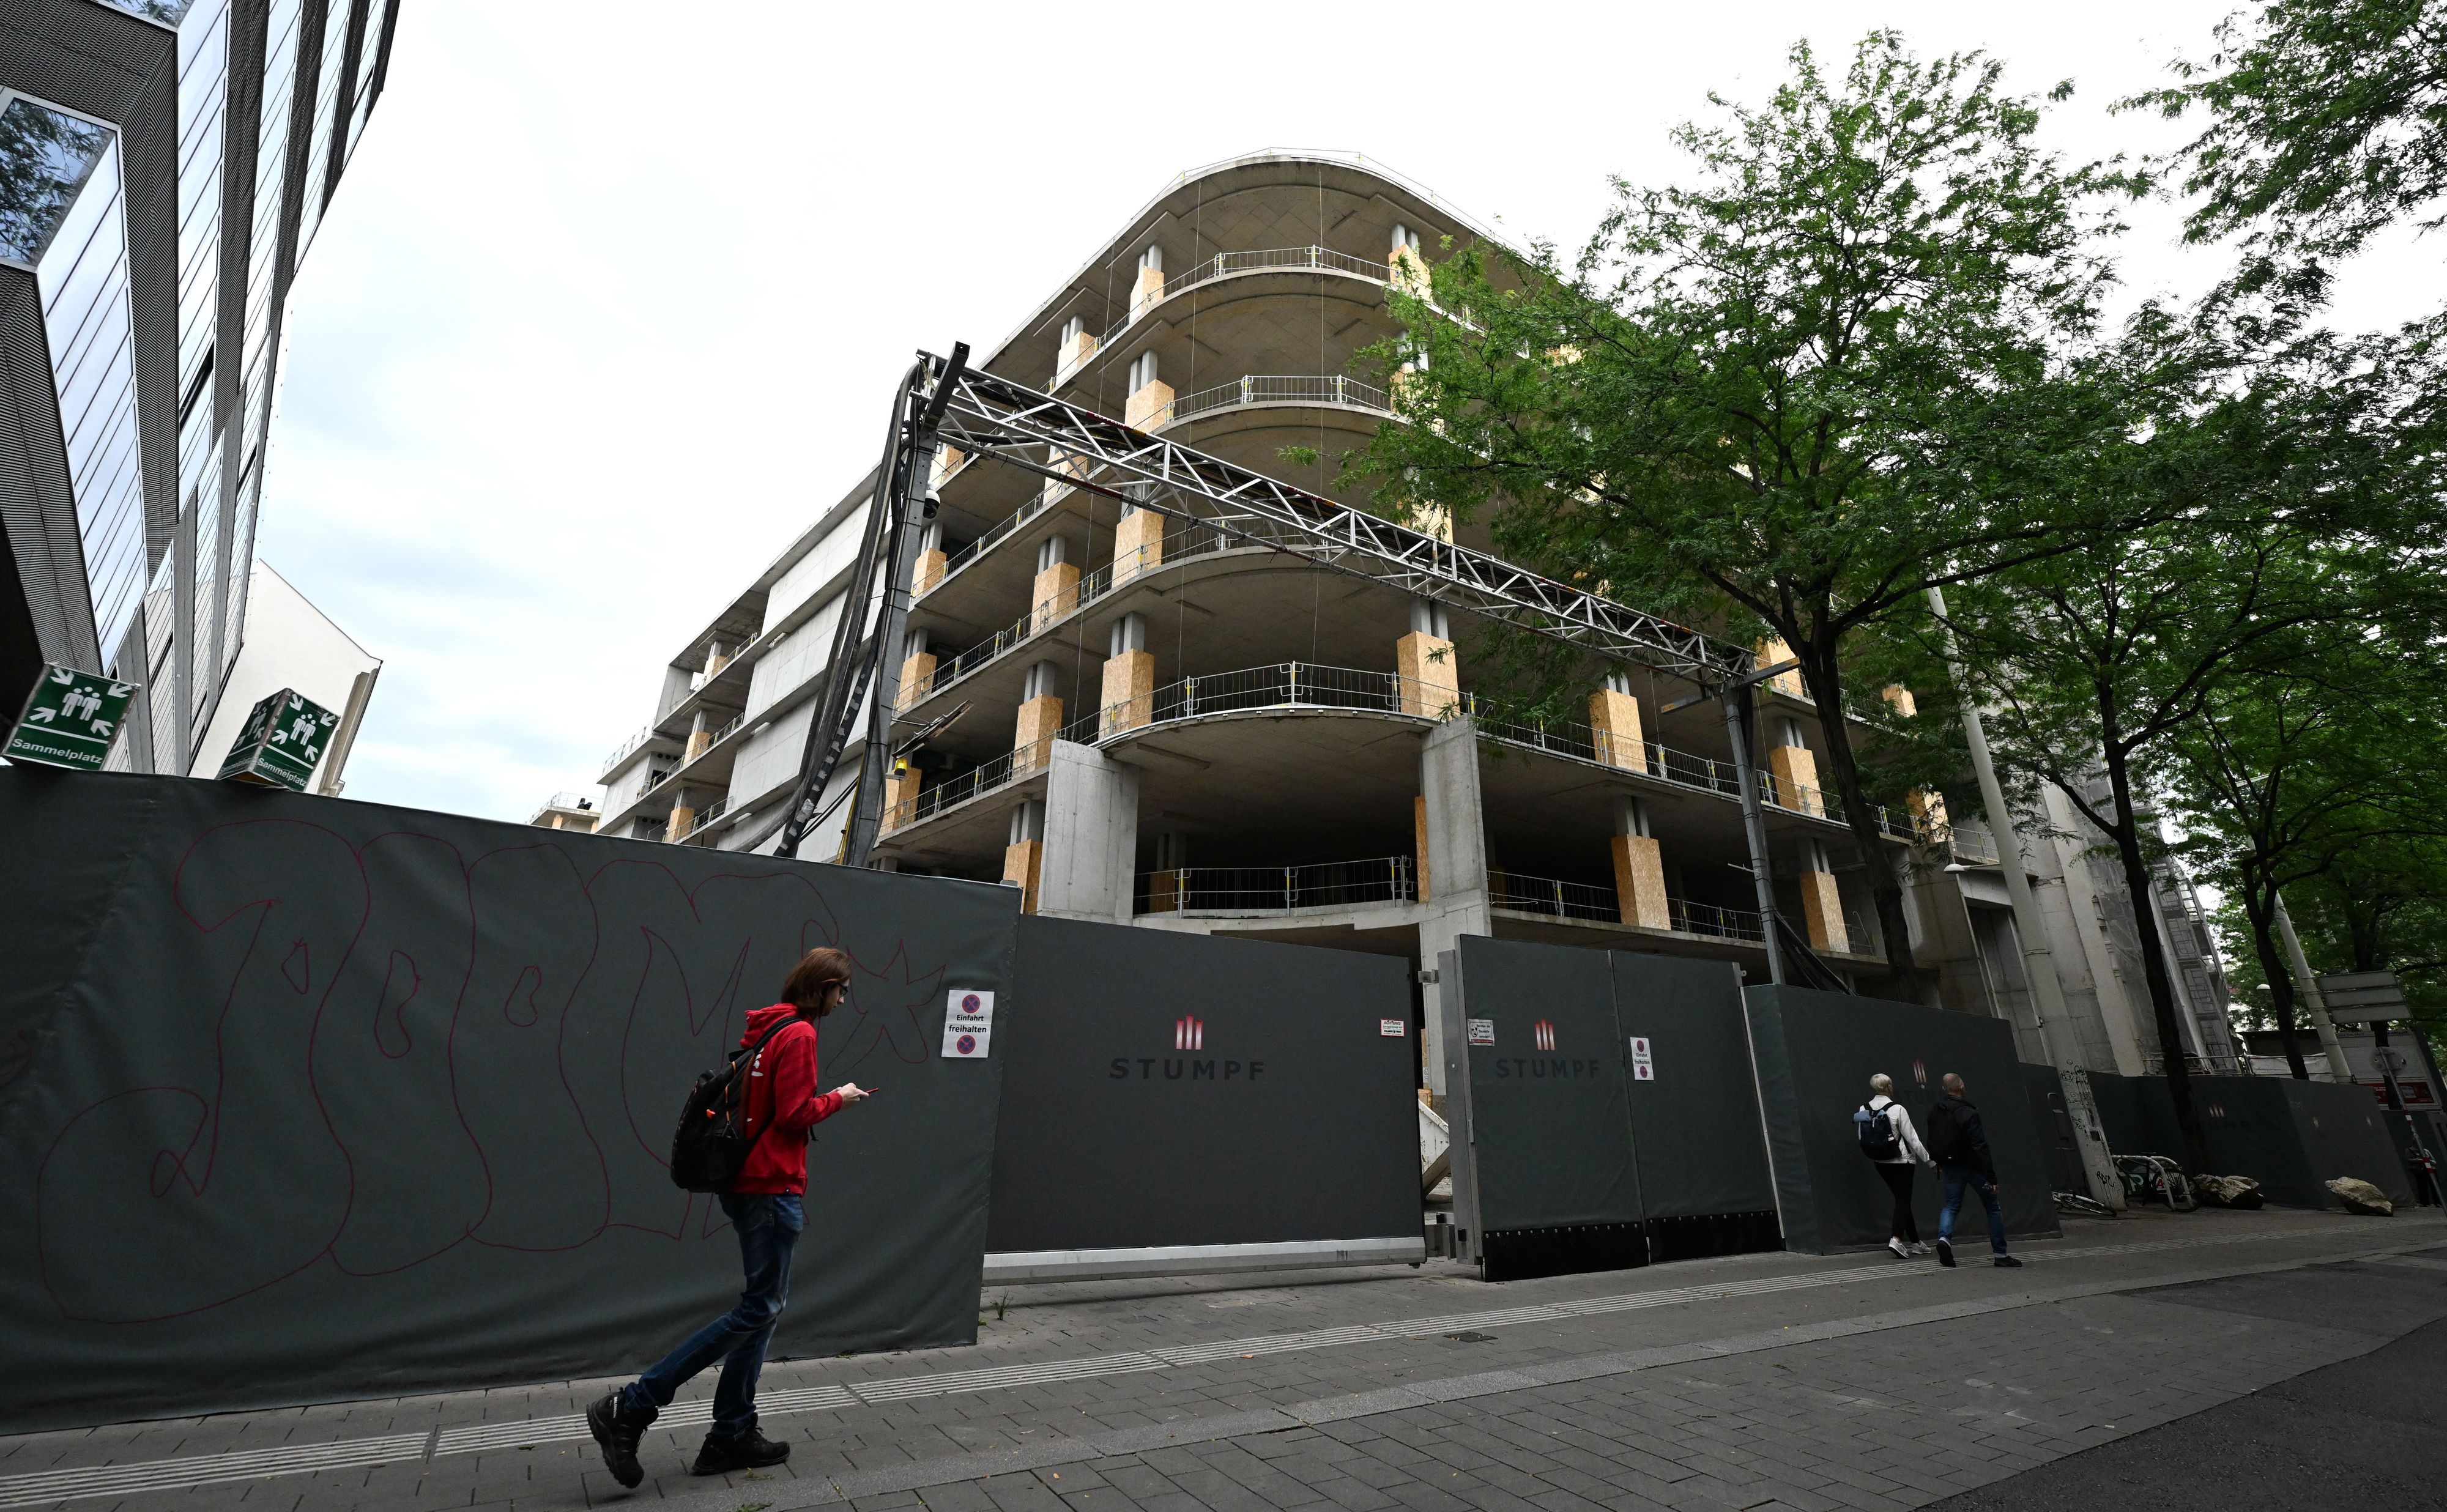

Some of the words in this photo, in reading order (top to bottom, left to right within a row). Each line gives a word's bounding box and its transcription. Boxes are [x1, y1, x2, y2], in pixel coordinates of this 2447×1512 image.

[12, 738, 103, 764] Sammelplatz
[258, 757, 308, 787] Sammelplatz
[949, 1025, 987, 1033] freihalten
[1109, 1057, 1264, 1081] STUMPF
[1496, 1058, 1600, 1078] STUMPF
